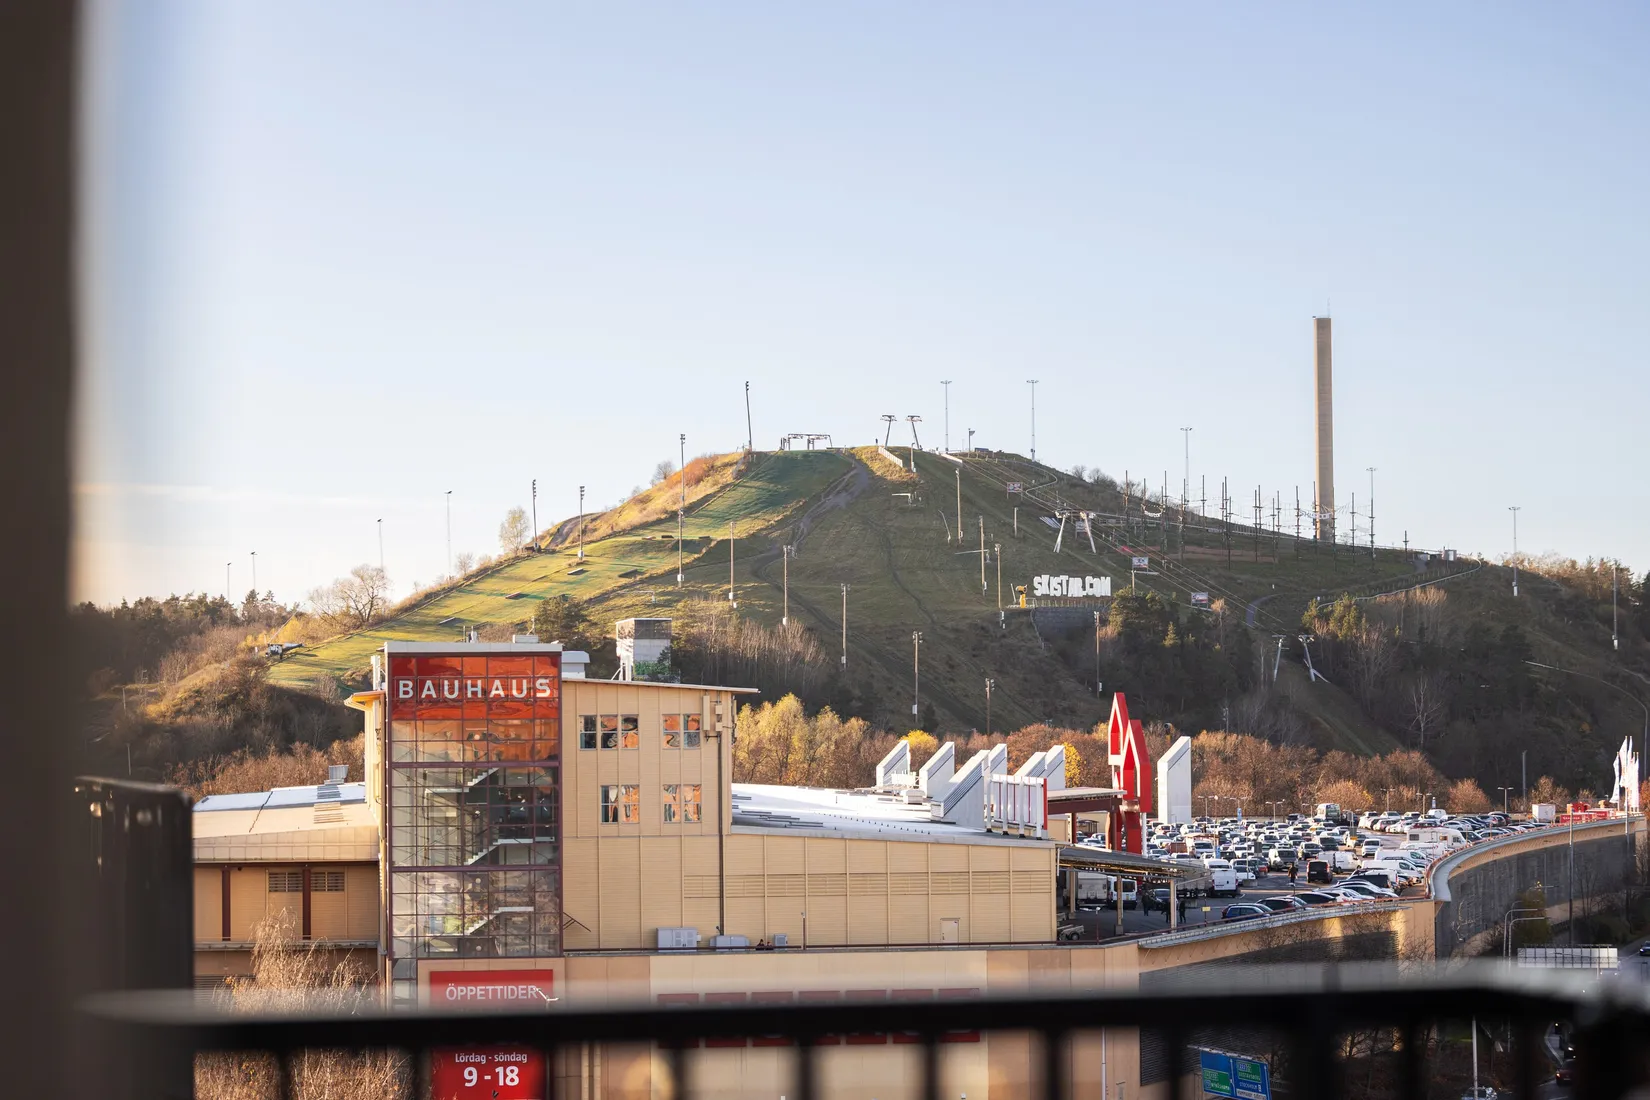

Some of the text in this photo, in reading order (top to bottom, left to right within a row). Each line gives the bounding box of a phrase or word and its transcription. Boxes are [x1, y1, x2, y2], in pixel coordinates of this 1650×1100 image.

[1033, 575, 1111, 597] SKISTAR.COM
[398, 678, 551, 699] BAUHAUS
[446, 983, 538, 1000] ÖPPETTIDER
[455, 1053, 486, 1064] Lördag
[494, 1053, 527, 1063] söndag
[463, 1066, 478, 1087] 9
[495, 1066, 520, 1087] 18
